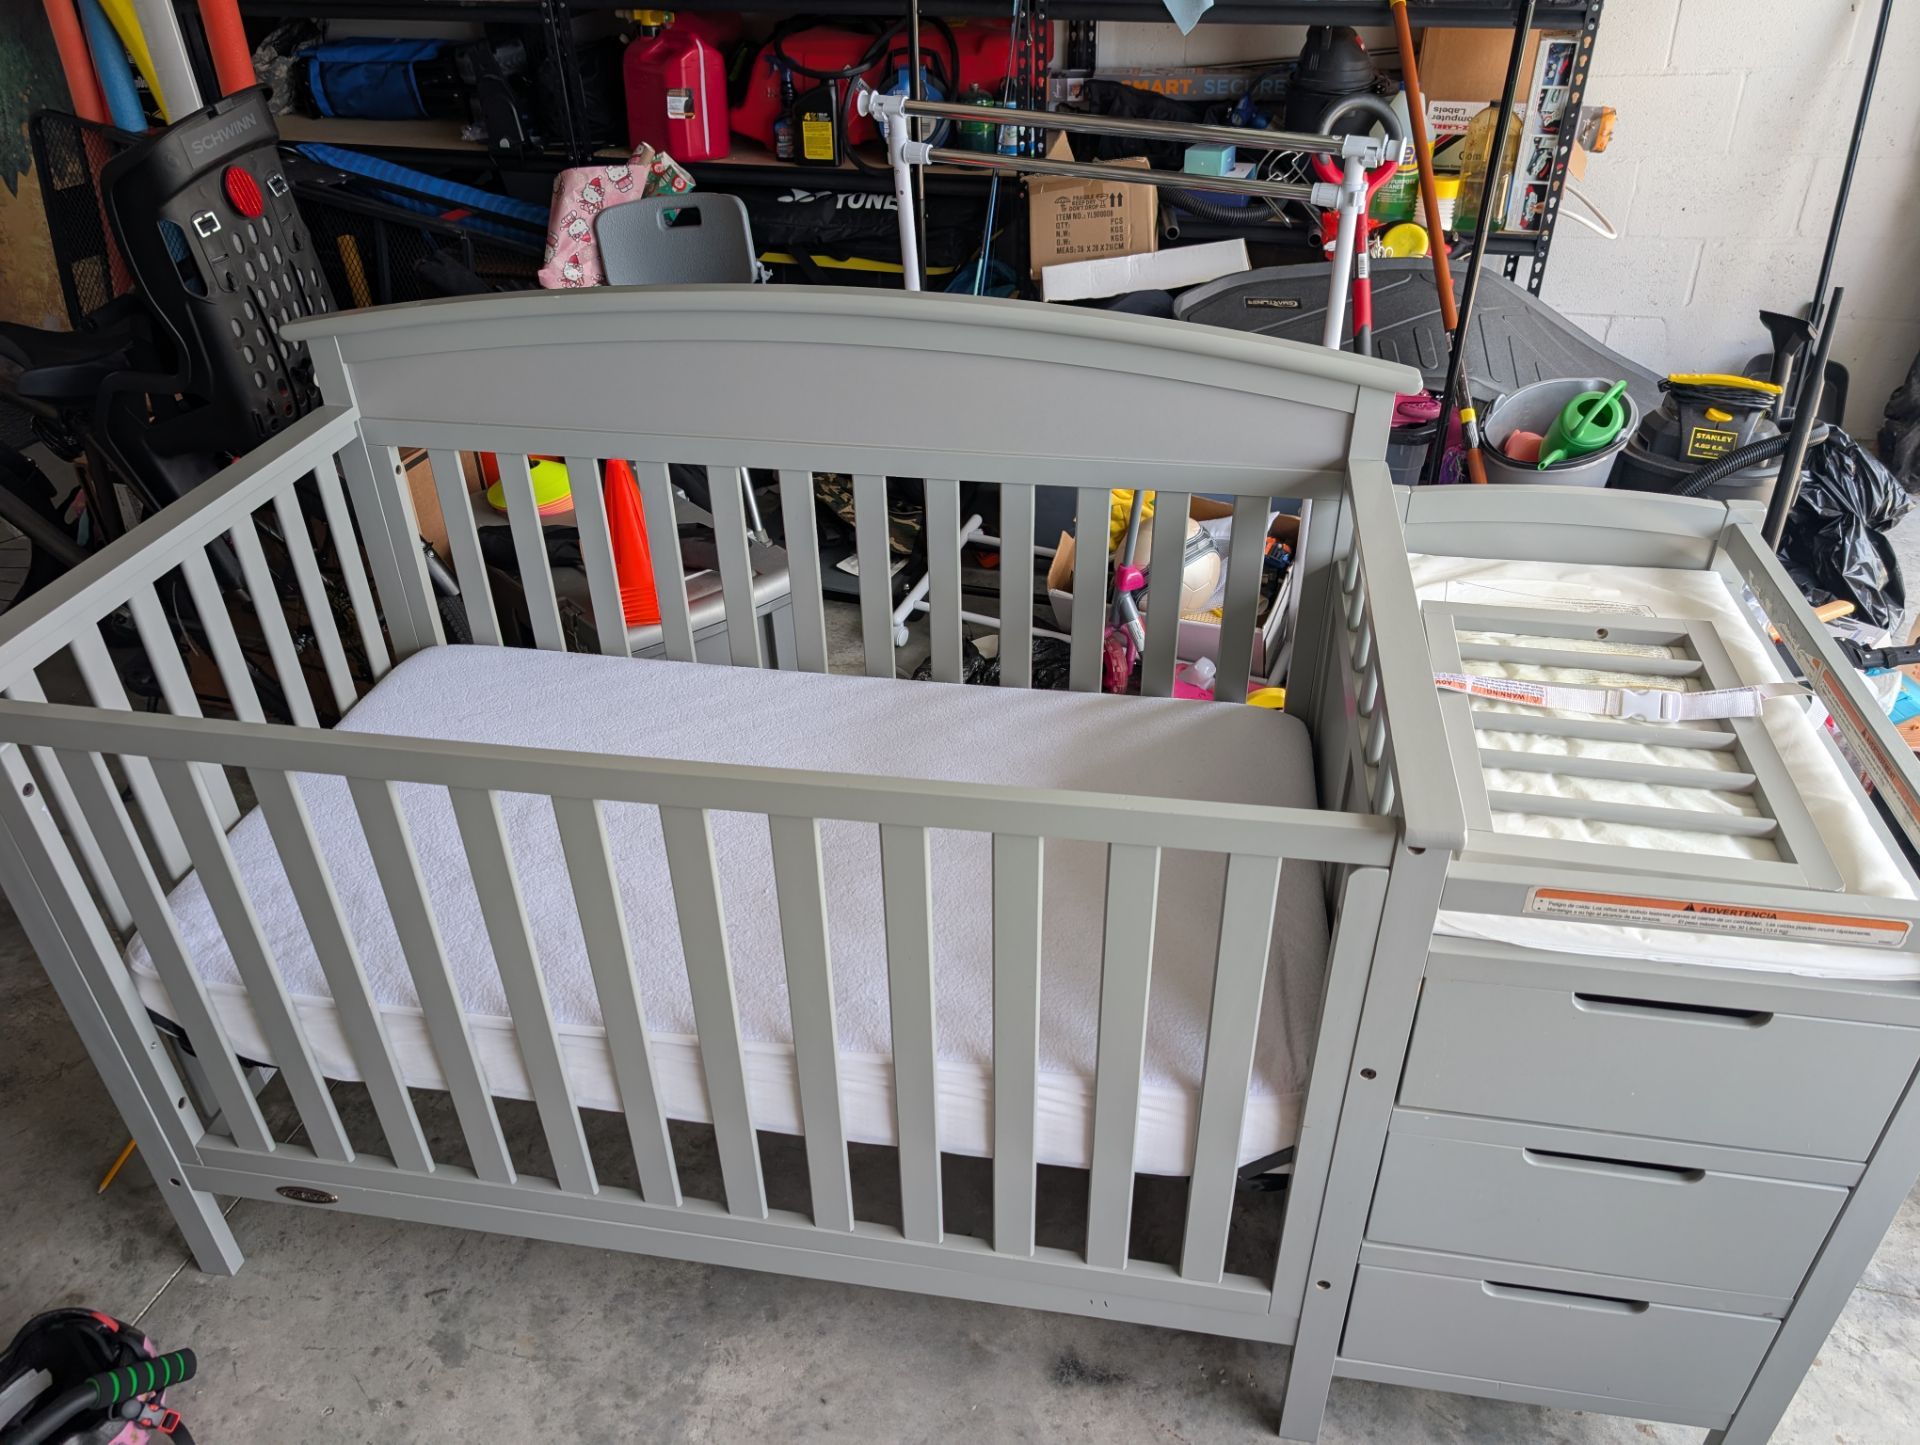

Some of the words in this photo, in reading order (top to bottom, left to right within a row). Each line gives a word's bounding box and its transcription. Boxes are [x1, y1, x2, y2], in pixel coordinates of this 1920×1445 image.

[1433, 106, 1466, 115] Labels
[1431, 114, 1473, 122] omputer
[191, 113, 257, 154] SCHWINN
[836, 193, 899, 211] YONE
[1056, 212, 1072, 221] ITEM
[1696, 433, 1733, 443] STANLEY
[1486, 688, 1525, 700] WARNING
[1700, 906, 1777, 920] ADVERTENCIA
